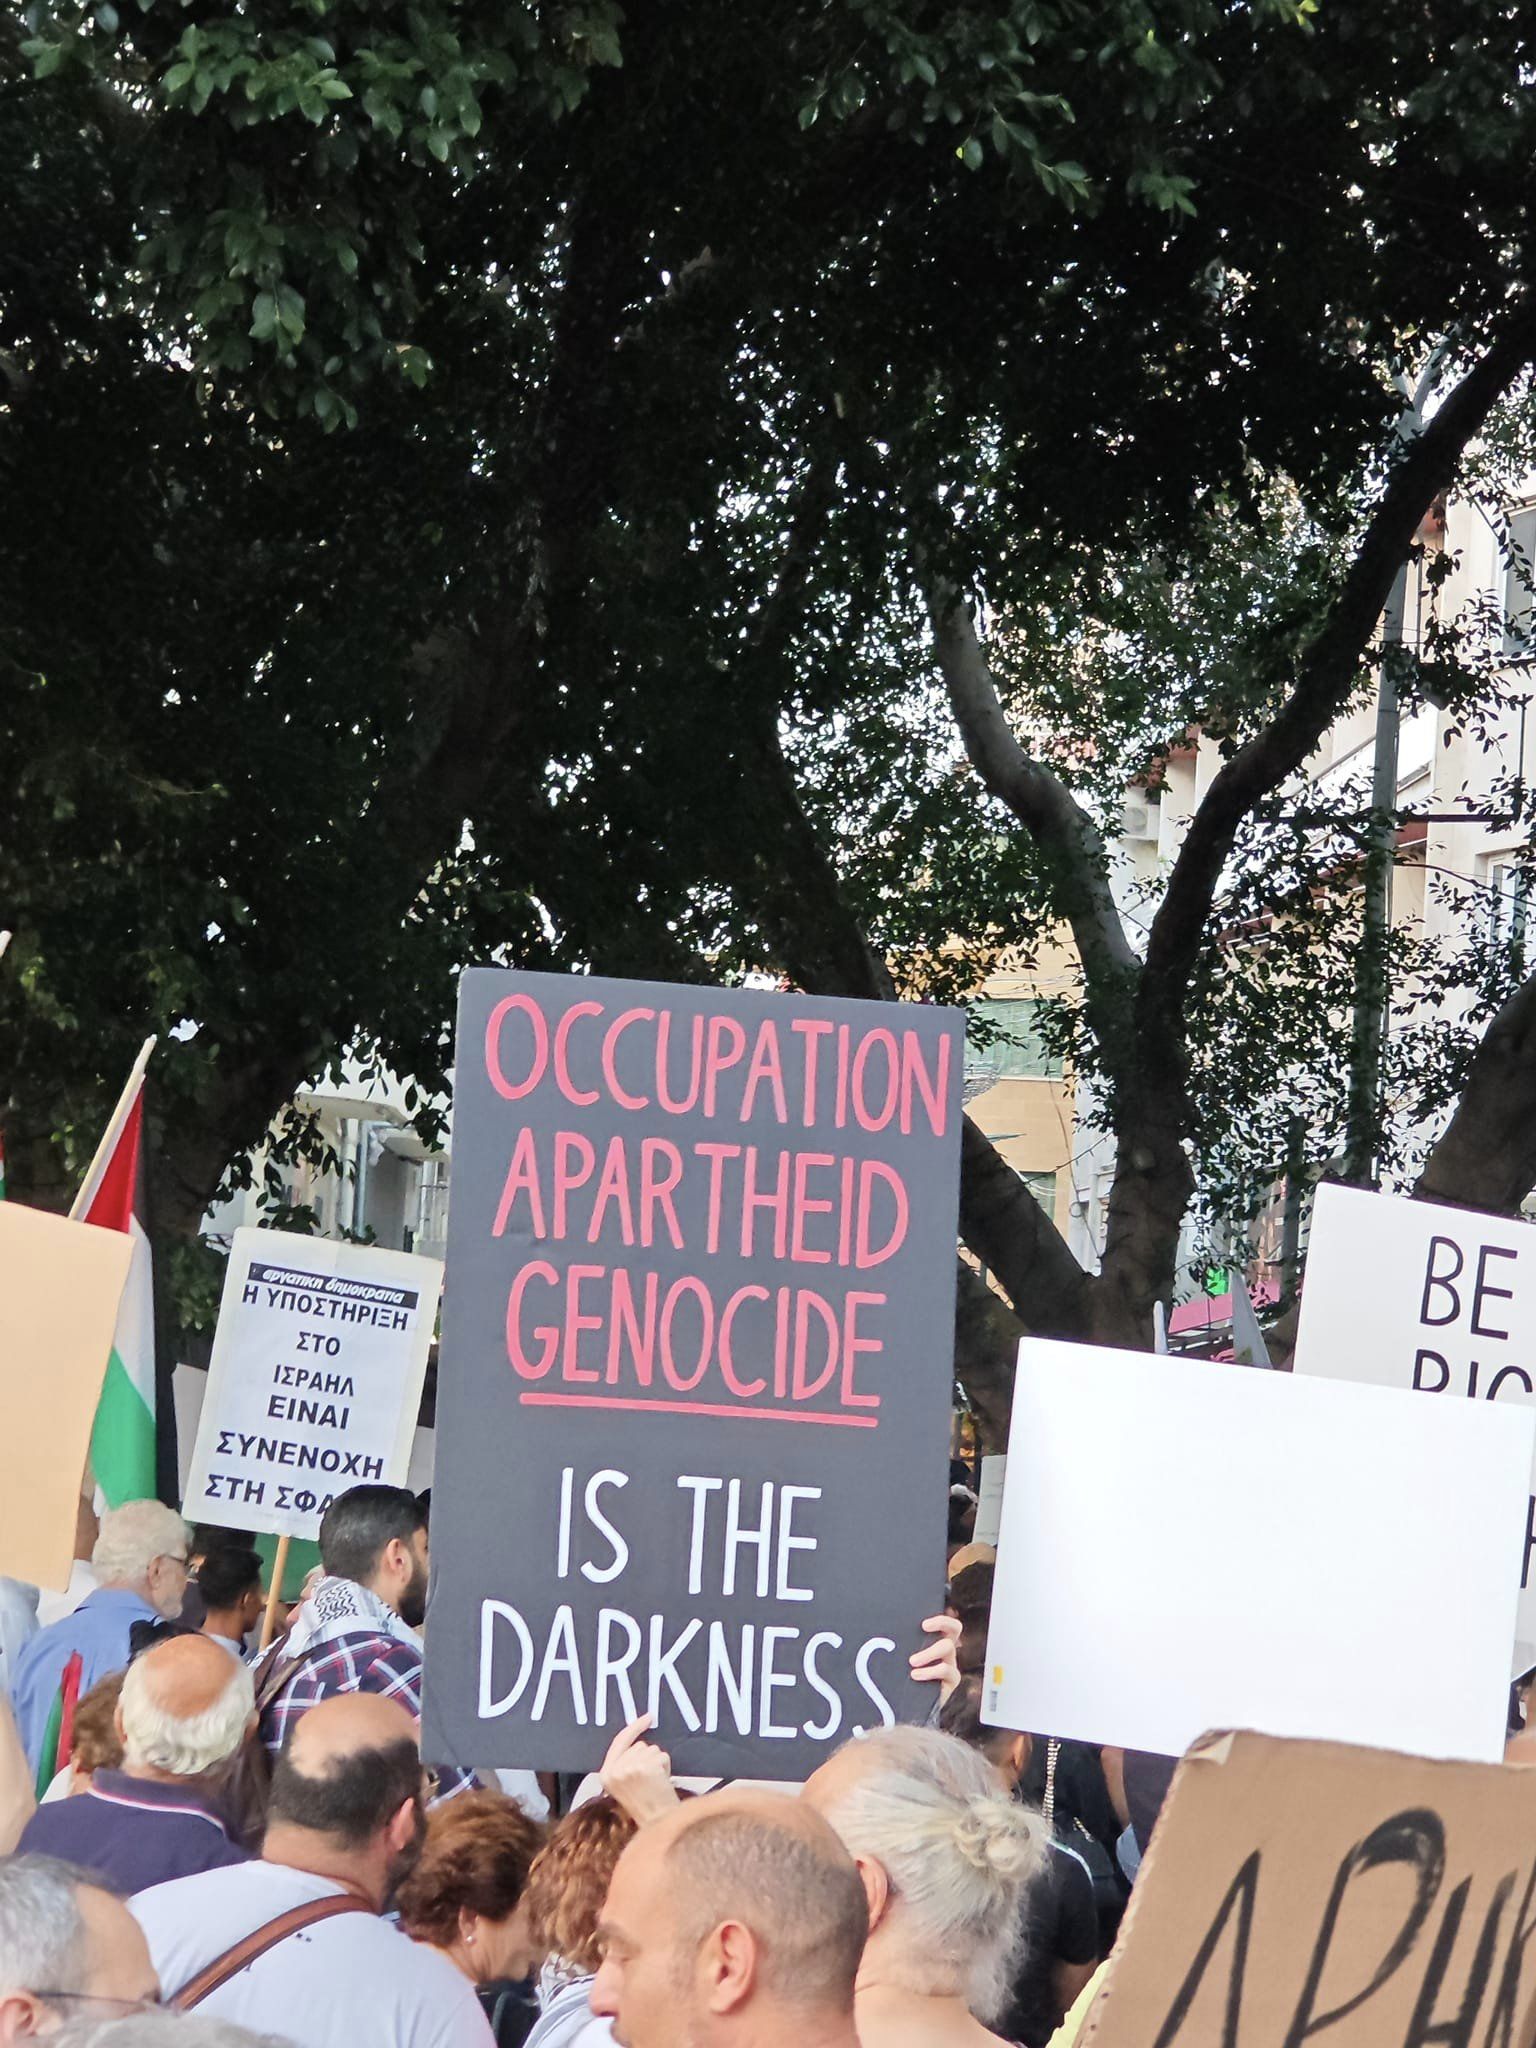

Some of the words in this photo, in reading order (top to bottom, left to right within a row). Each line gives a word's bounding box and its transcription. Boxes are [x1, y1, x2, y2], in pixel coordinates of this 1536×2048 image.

[485, 993, 951, 1136] OCCUPATION
[491, 1127, 909, 1269] APARTHEID
[242, 1284, 259, 1305] Η
[267, 1287, 409, 1331] ΥΠΟΣΤΗΡΙΞΗ
[1419, 1235, 1518, 1340] BE
[296, 1331, 341, 1356] ΣΤΟ
[505, 1260, 888, 1407] GENOCIDE
[267, 1394, 350, 1430] ΕΙΝΑΙ
[273, 1364, 355, 1397] ΙΣΡΑΗΛ
[205, 1474, 265, 1505] ΣΤΗ
[215, 1431, 384, 1480] ΣΥΝΕΝΟΧΗ
[557, 1466, 629, 1583] IS
[677, 1475, 822, 1601] THE
[478, 1598, 896, 1740] DARKNESS
